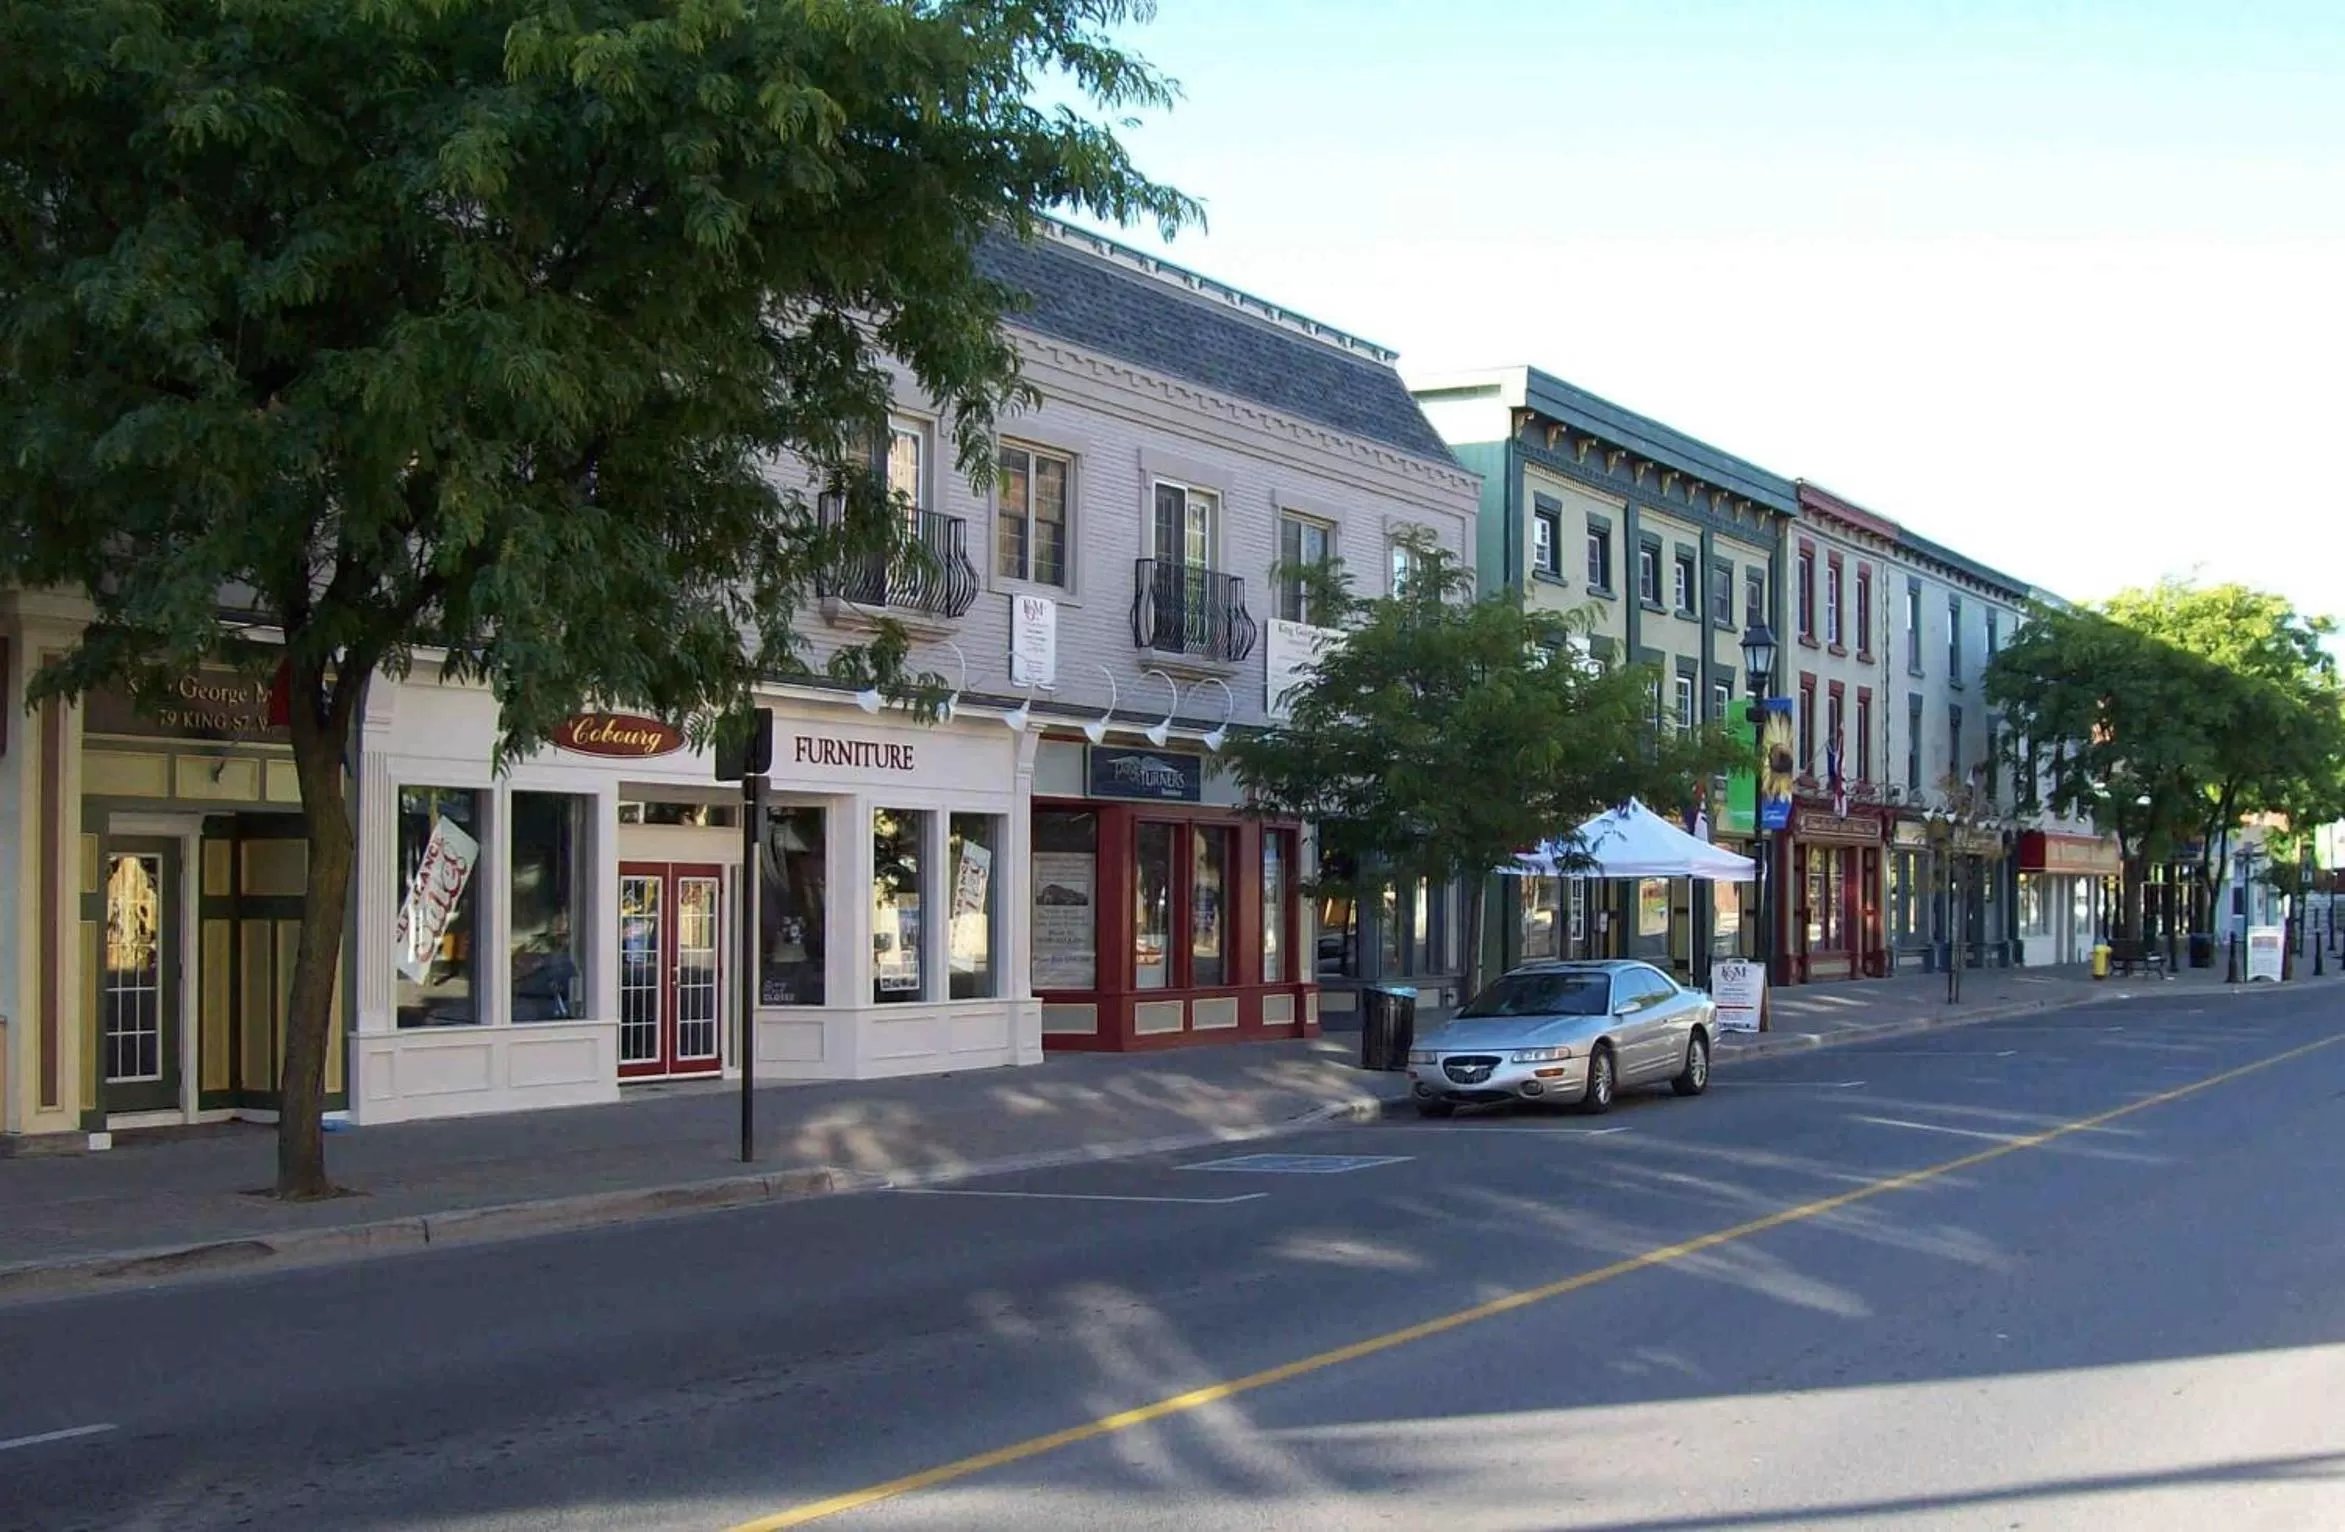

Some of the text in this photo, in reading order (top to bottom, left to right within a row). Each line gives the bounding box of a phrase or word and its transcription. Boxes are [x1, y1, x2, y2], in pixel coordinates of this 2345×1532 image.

[178, 675, 248, 704] George
[183, 710, 227, 730] KING
[571, 716, 664, 754] Cobourg
[794, 735, 915, 770] FURNITURE
[1140, 770, 1185, 789] TURNERS
